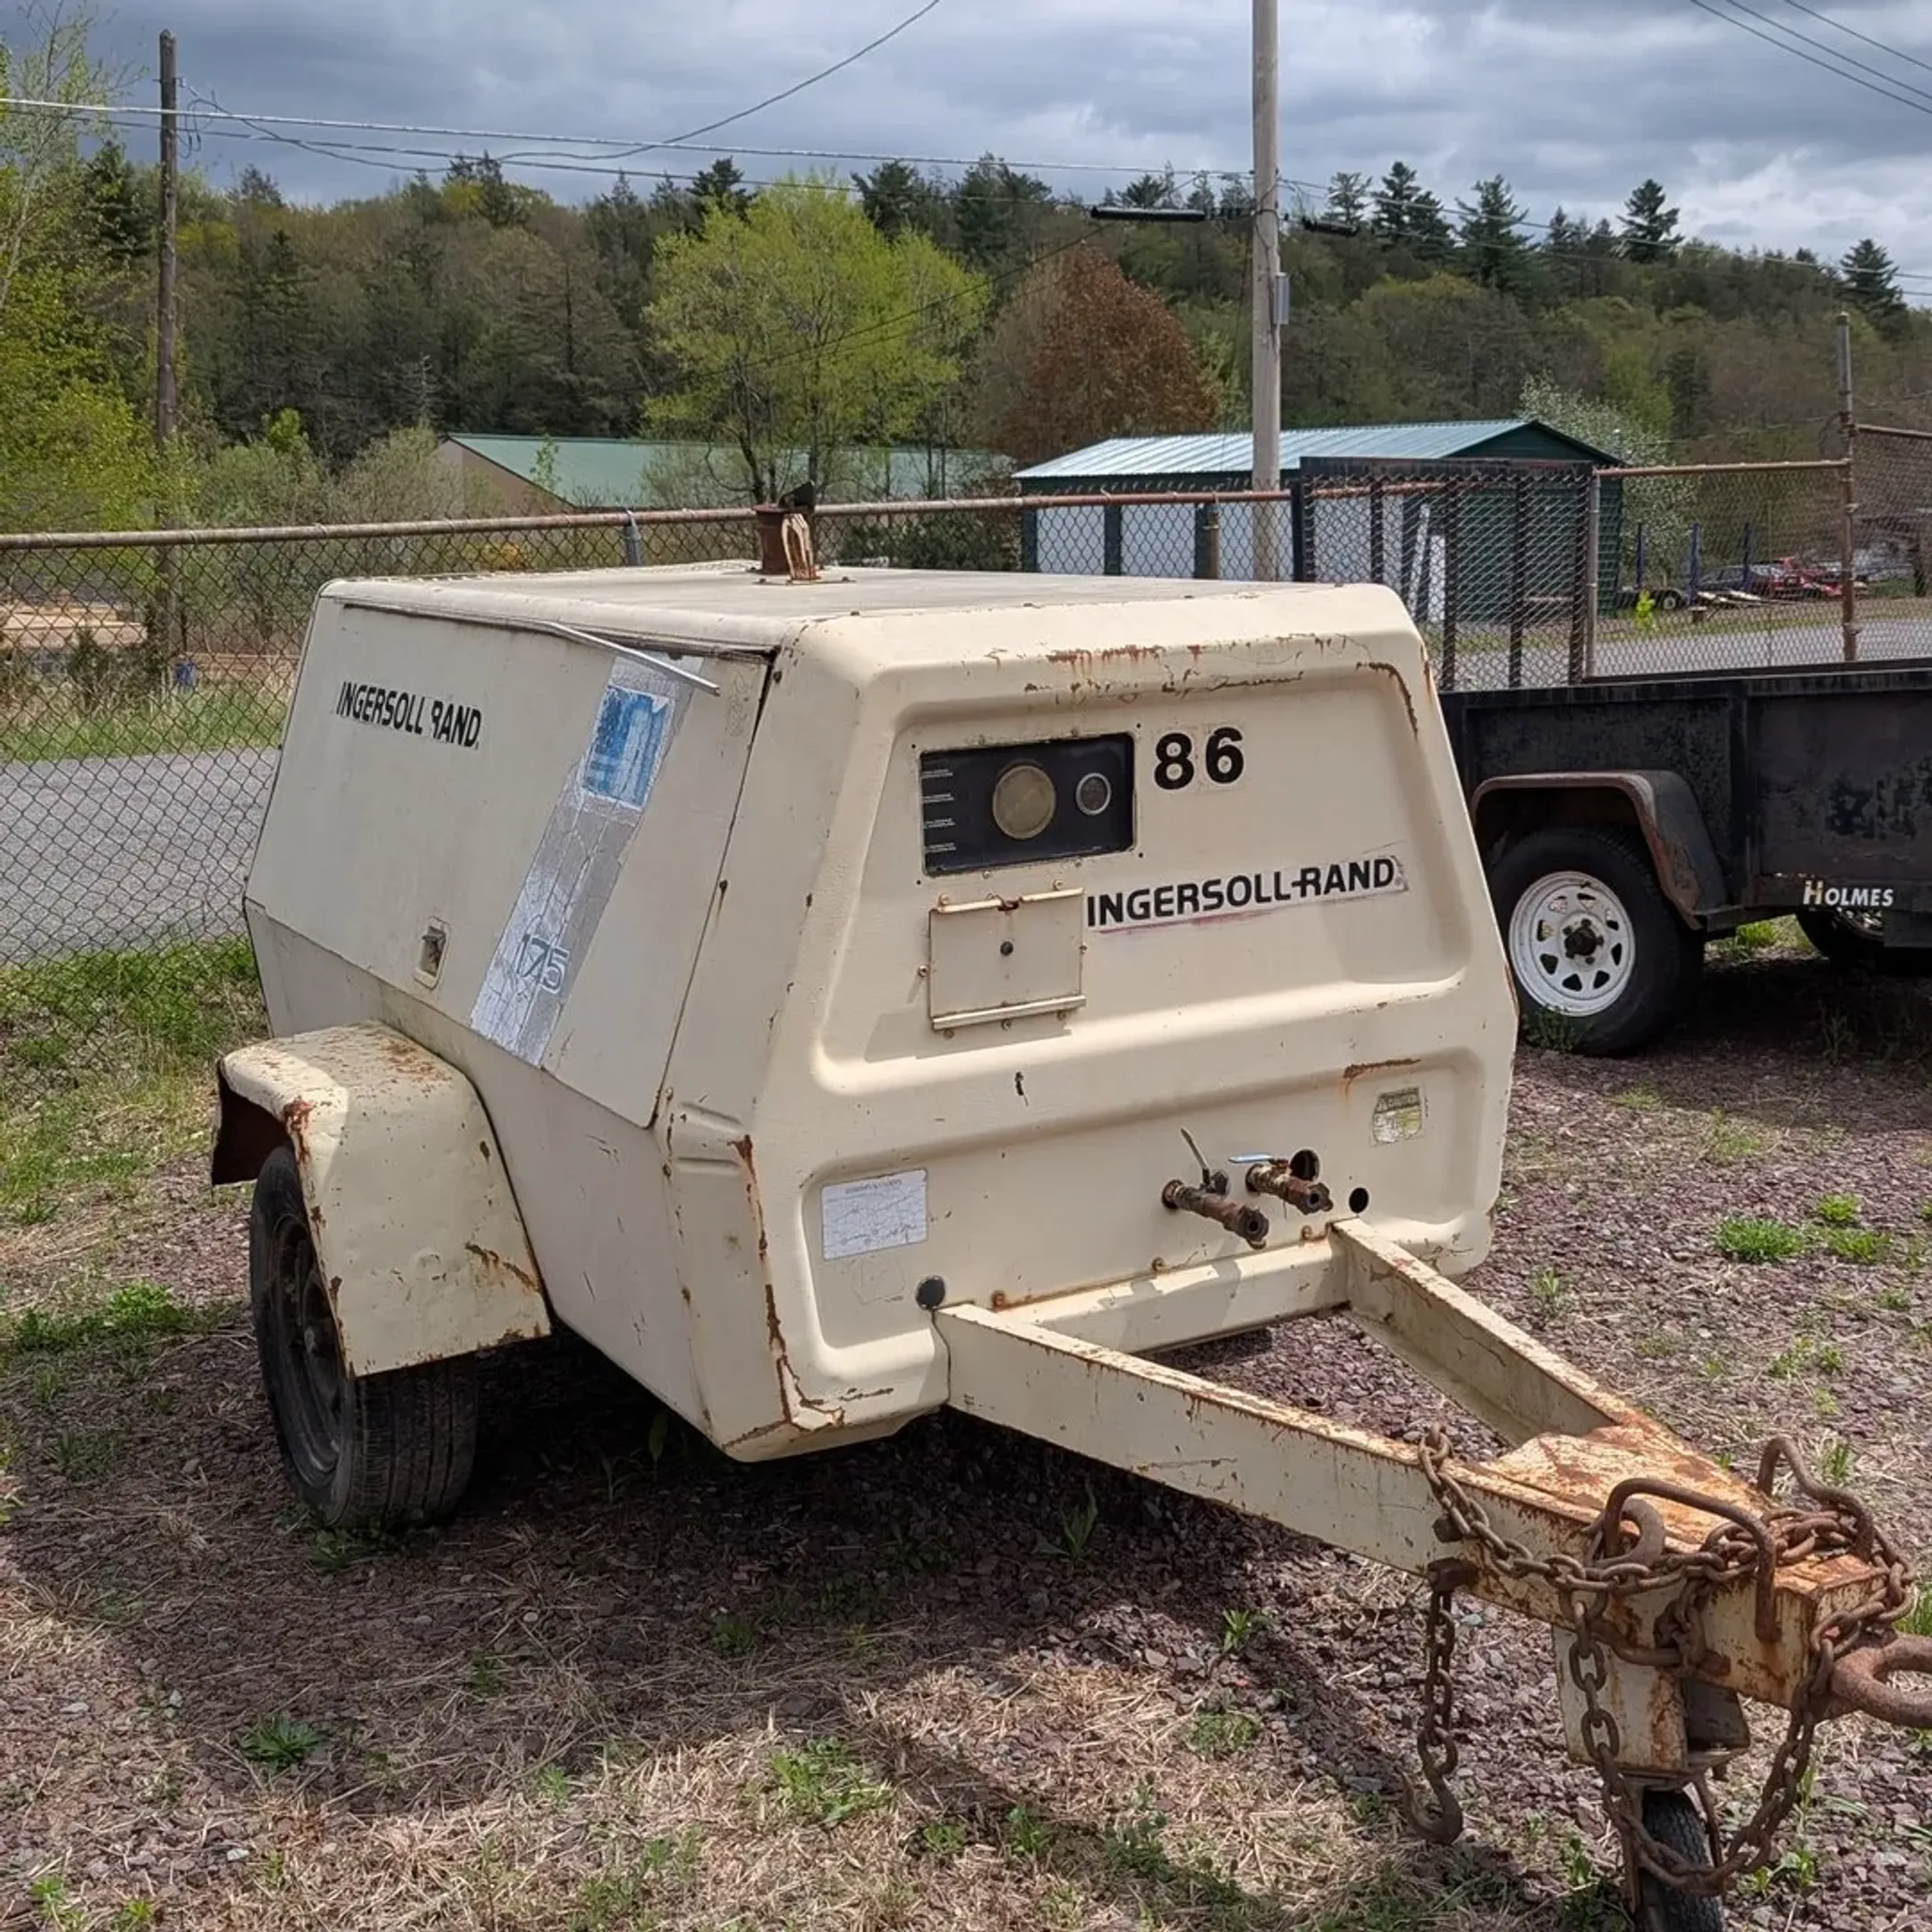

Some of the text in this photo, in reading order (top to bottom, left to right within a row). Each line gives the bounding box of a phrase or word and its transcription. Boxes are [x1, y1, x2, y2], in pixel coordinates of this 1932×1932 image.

[336, 681, 425, 734] INGERSOLL
[1154, 726, 1244, 790] 86
[1088, 859, 1394, 927] INGERSOLL-RAND
[1803, 880, 1894, 907] HOLMES
[516, 934, 569, 991] 175
